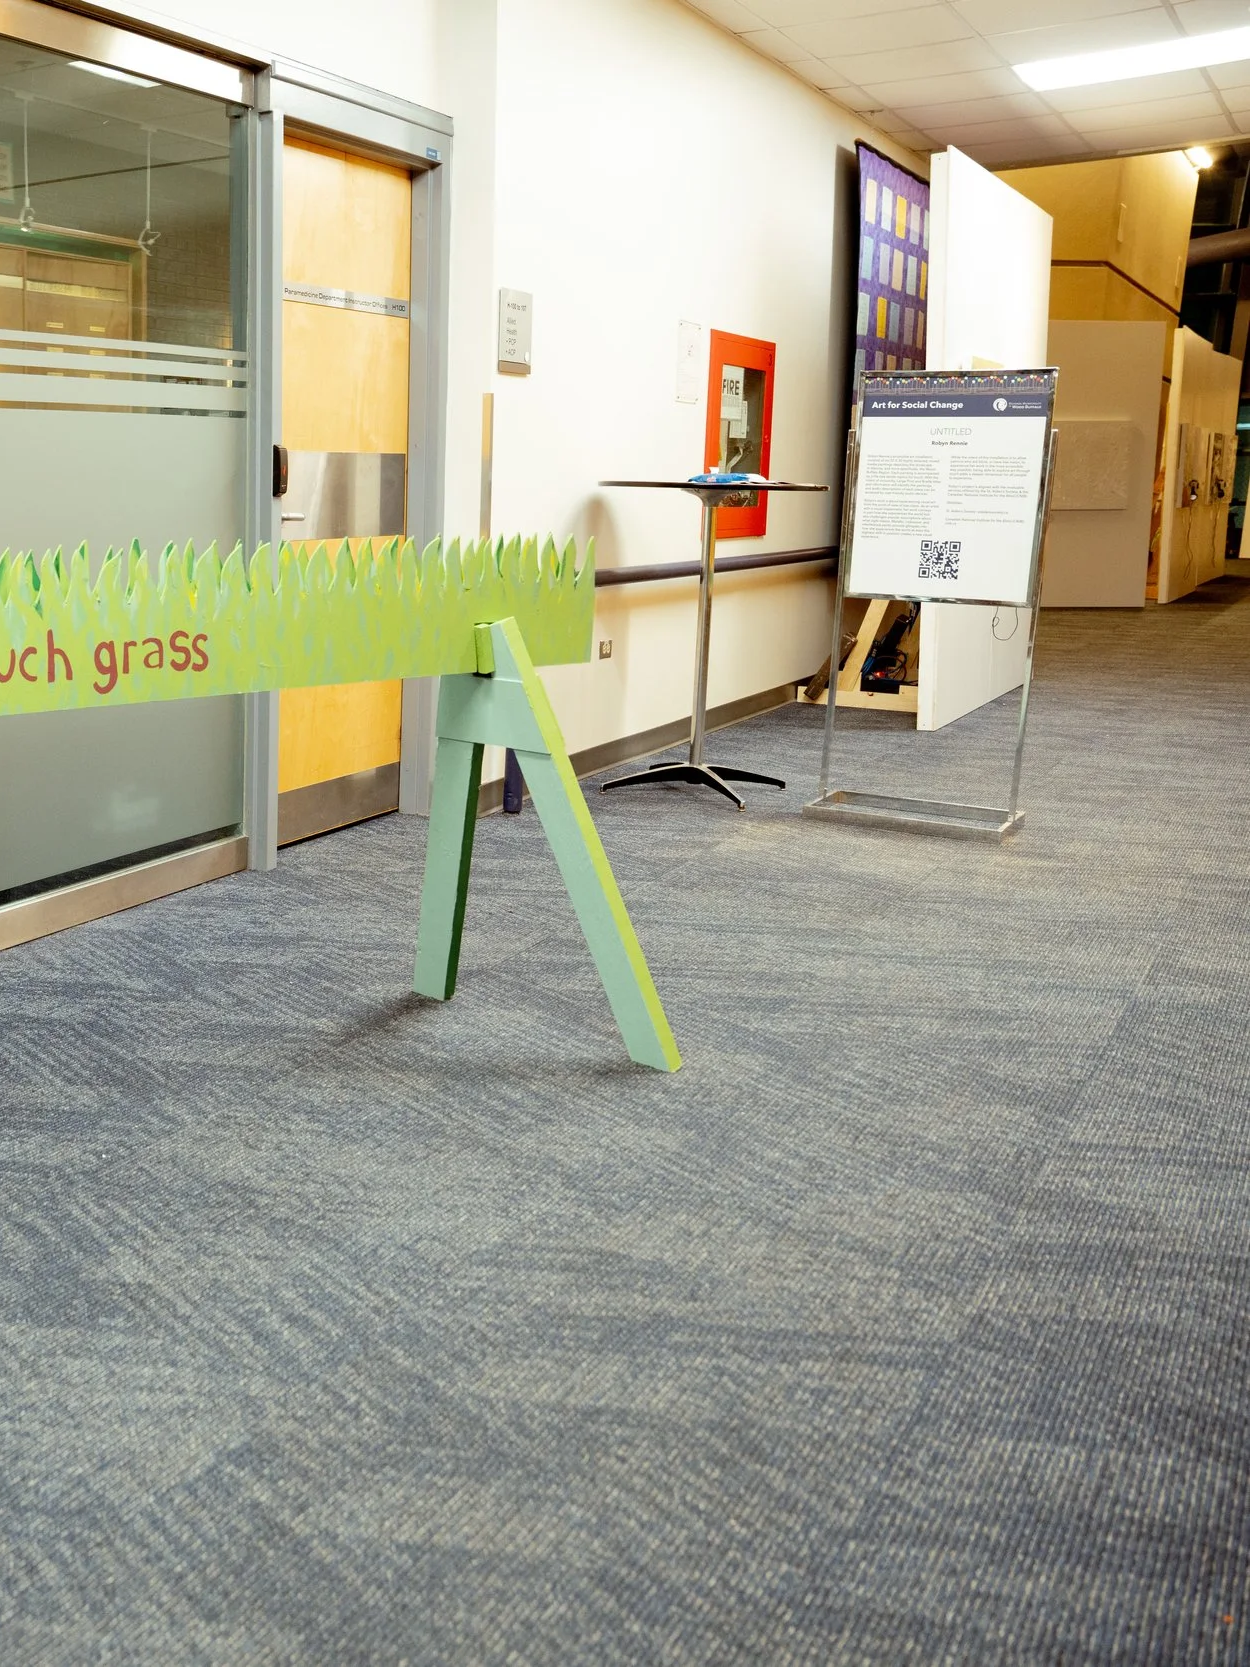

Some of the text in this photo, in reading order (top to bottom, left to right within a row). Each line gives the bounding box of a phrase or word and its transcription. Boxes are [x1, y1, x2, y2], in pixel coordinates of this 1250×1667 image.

[284, 287, 318, 299] Paramedicine
[722, 378, 740, 396] FIRE
[871, 401, 964, 411] Art for Social Change
[930, 427, 972, 436] UNTITLED
[93, 630, 209, 694] grass
